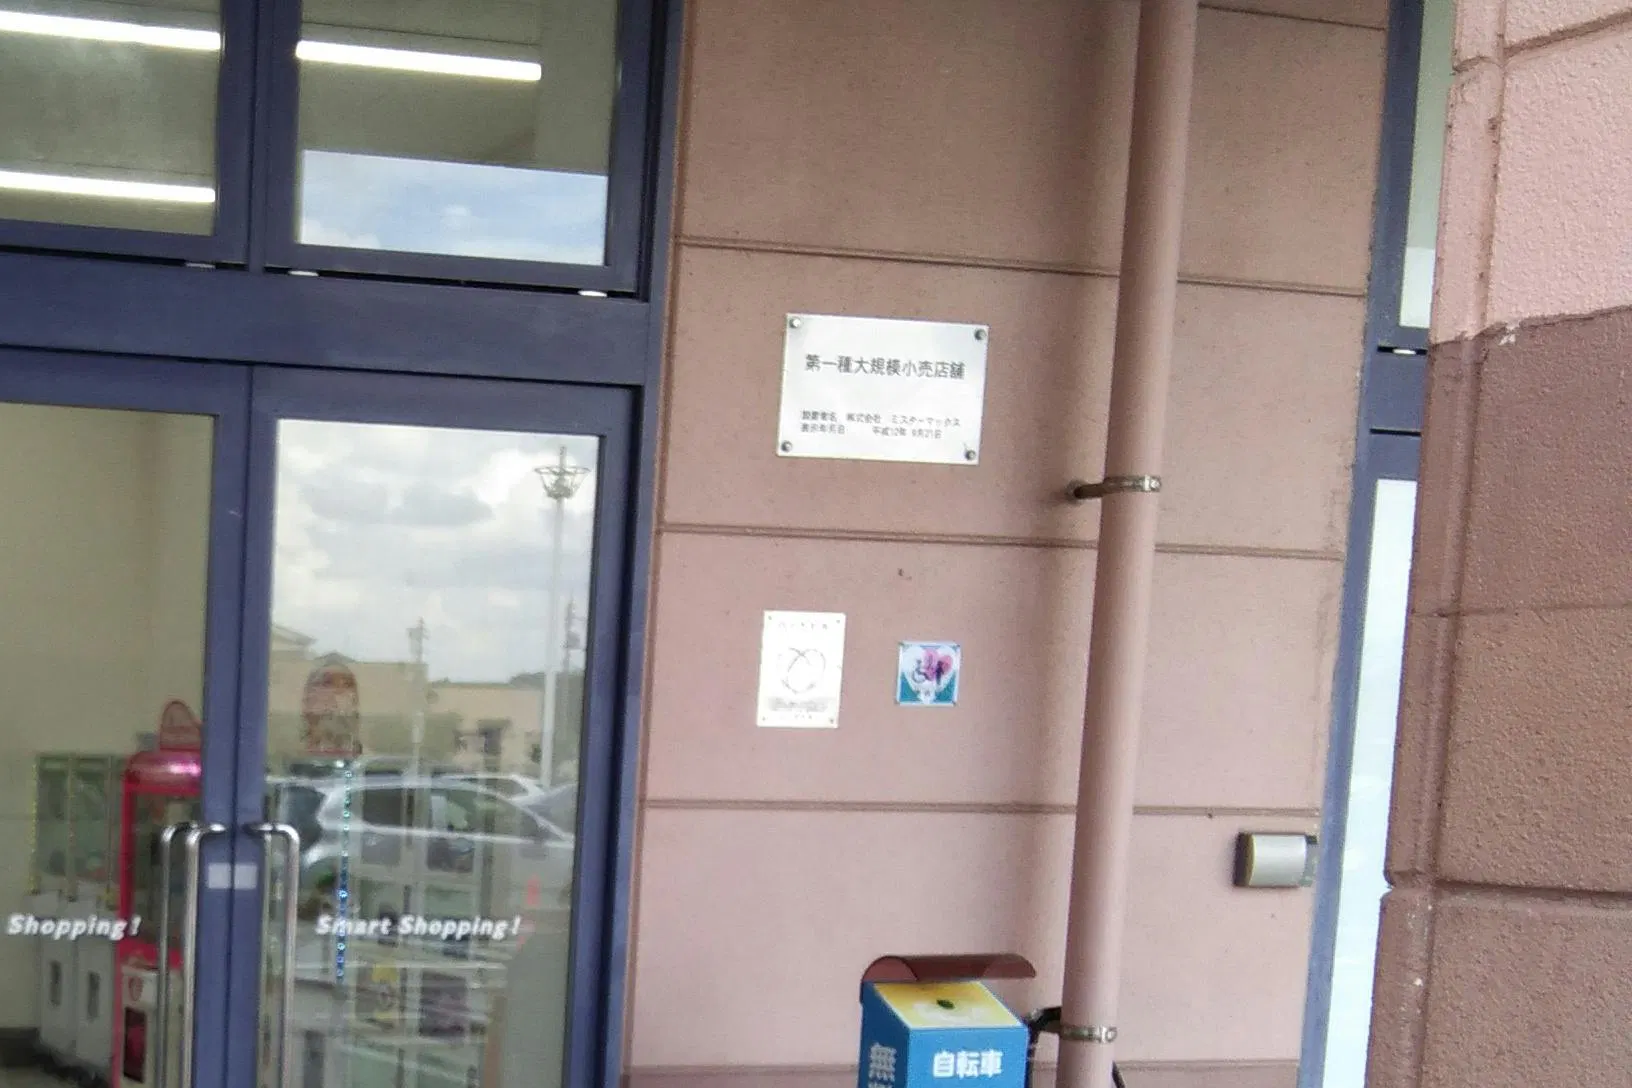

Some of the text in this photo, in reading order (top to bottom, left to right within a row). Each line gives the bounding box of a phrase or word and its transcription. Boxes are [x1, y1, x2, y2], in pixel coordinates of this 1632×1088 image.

[805, 354, 966, 380] 第一種大規模小売店舗
[315, 912, 392, 935] Smart
[932, 1048, 1004, 1079] 自転車
